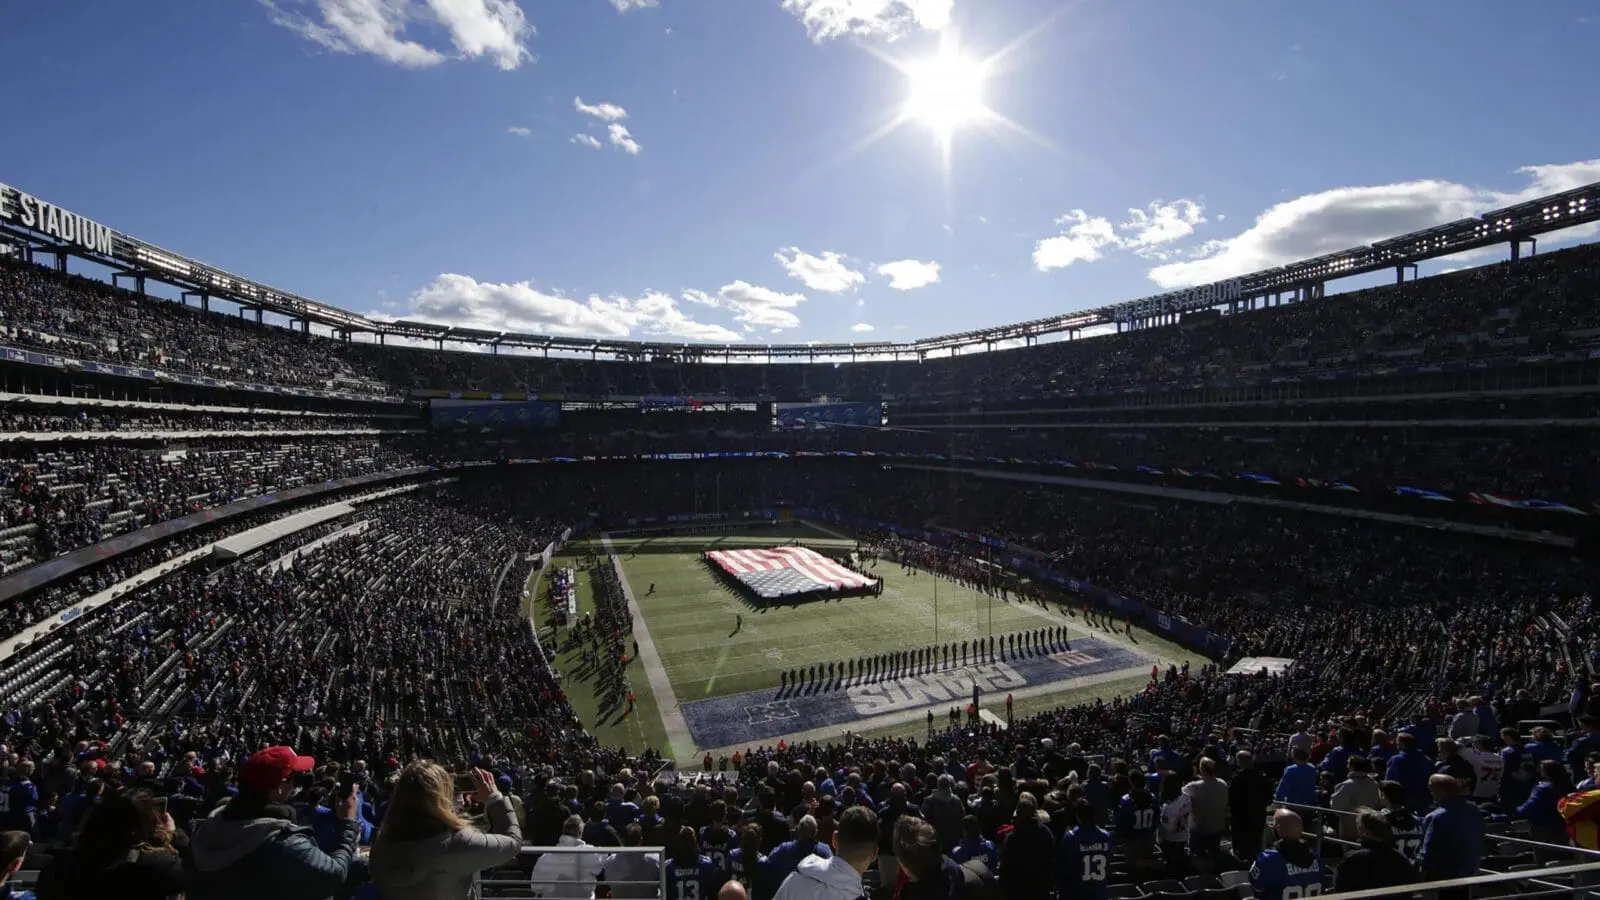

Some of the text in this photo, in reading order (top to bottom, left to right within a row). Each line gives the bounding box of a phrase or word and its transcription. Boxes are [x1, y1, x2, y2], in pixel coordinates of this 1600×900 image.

[19, 193, 112, 256] STADIUM
[1171, 279, 1242, 313] STADIUM
[1132, 808, 1155, 831] 10
[1081, 853, 1107, 882] 13
[675, 879, 700, 900] 13
